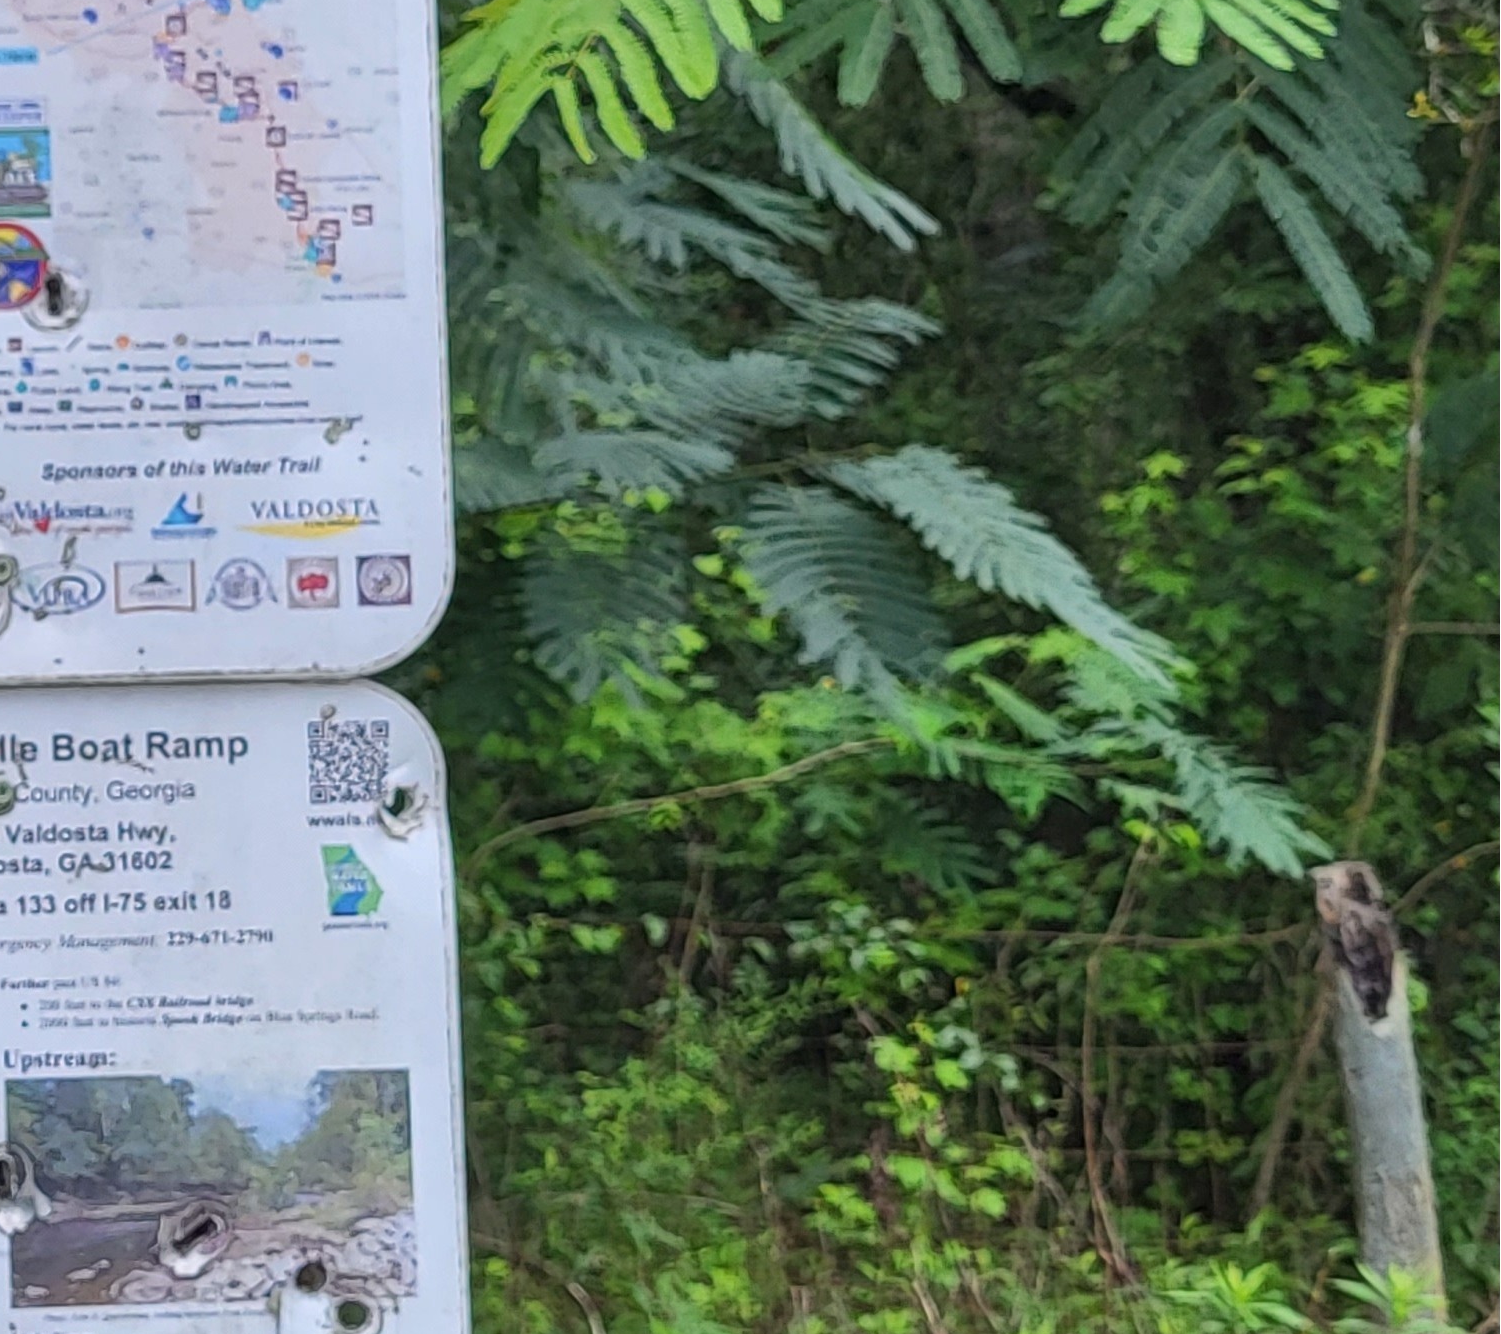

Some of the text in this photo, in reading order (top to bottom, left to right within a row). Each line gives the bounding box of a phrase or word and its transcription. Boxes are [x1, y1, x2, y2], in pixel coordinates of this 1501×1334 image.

[41, 456, 321, 483] Sponsors of this Water Trail
[251, 498, 380, 519] VALDOSTA
[52, 733, 132, 763] Boat
[146, 732, 248, 765] Ramp
[106, 779, 196, 804] Georgia
[5, 822, 109, 844] Valdosta
[58, 852, 94, 874] GA
[103, 850, 173, 873] 31602
[17, 894, 56, 915] 133
[64, 892, 96, 913] off
[103, 892, 146, 913] I-75
[154, 890, 197, 911] exit
[206, 889, 232, 910] 18
[4, 1049, 117, 1075] Upstream:
